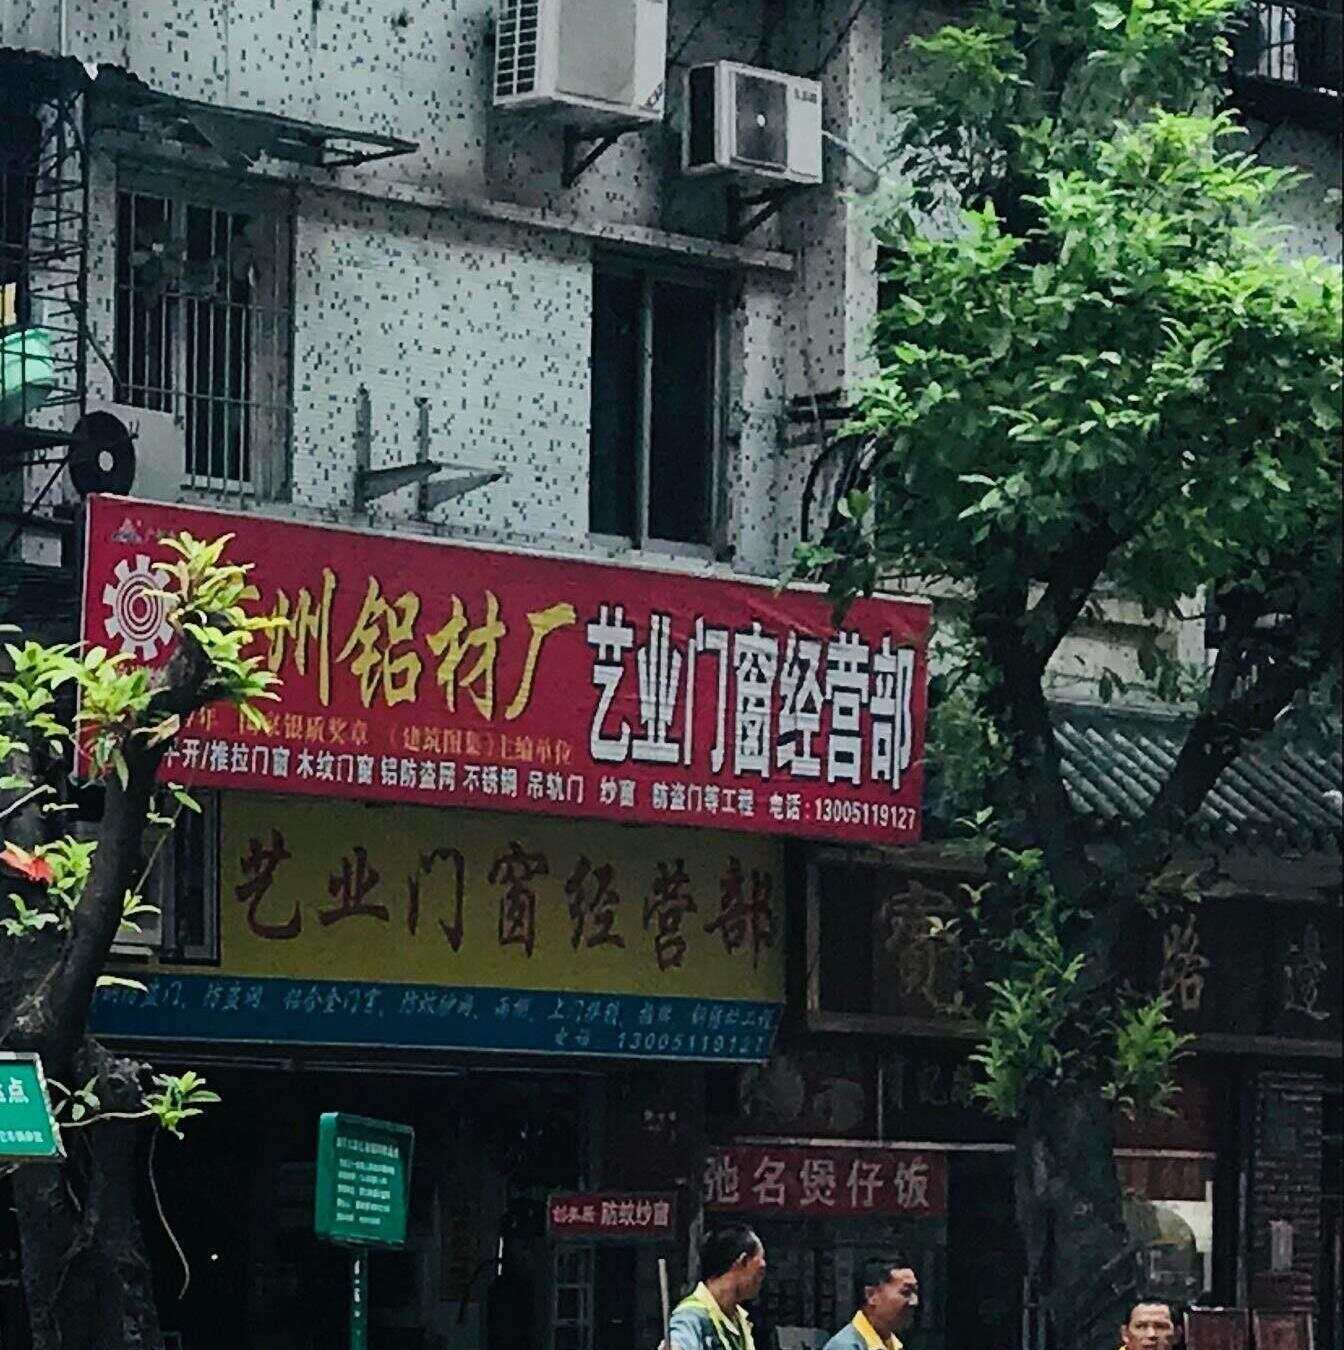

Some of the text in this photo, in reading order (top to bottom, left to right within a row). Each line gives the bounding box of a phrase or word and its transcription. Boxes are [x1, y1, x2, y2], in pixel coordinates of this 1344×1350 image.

[238, 567, 577, 722] 州铝材厂
[587, 604, 916, 790] 艺业门窗经营部
[296, 748, 374, 785] 木纹门窗
[380, 755, 456, 792] 铝防盗网
[462, 764, 518, 798] 不锈钢
[234, 827, 777, 972] 艺业门窗经营部
